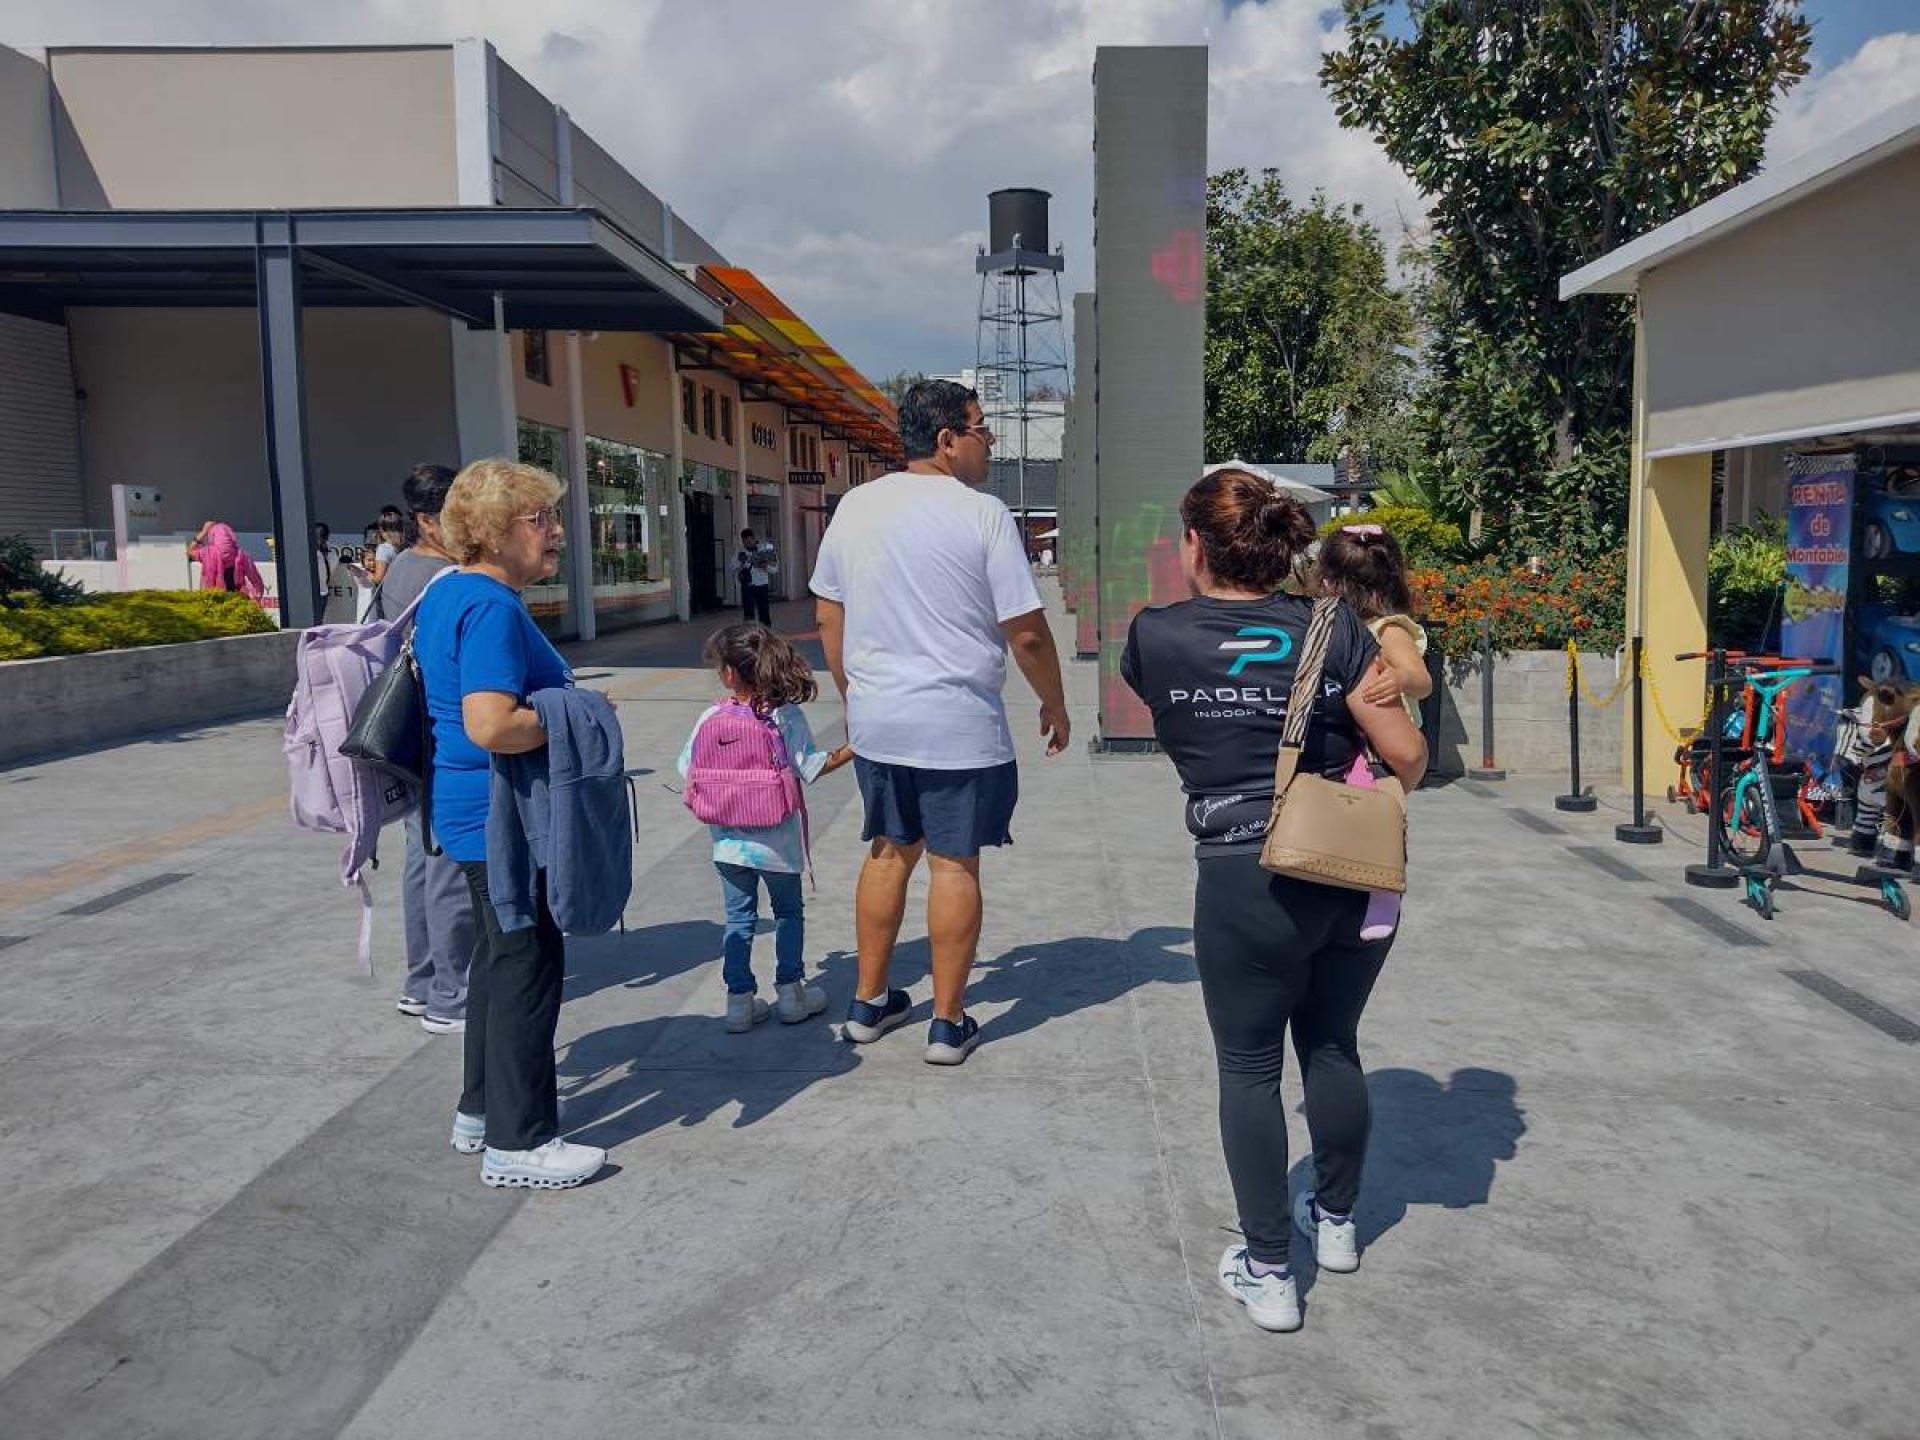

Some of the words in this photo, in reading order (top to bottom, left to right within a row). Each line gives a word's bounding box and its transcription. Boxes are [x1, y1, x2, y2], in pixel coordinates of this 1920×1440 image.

[1810, 512, 1831, 537] de
[1169, 687, 1287, 704] PADEL
[1194, 708, 1256, 718] INDOOR
